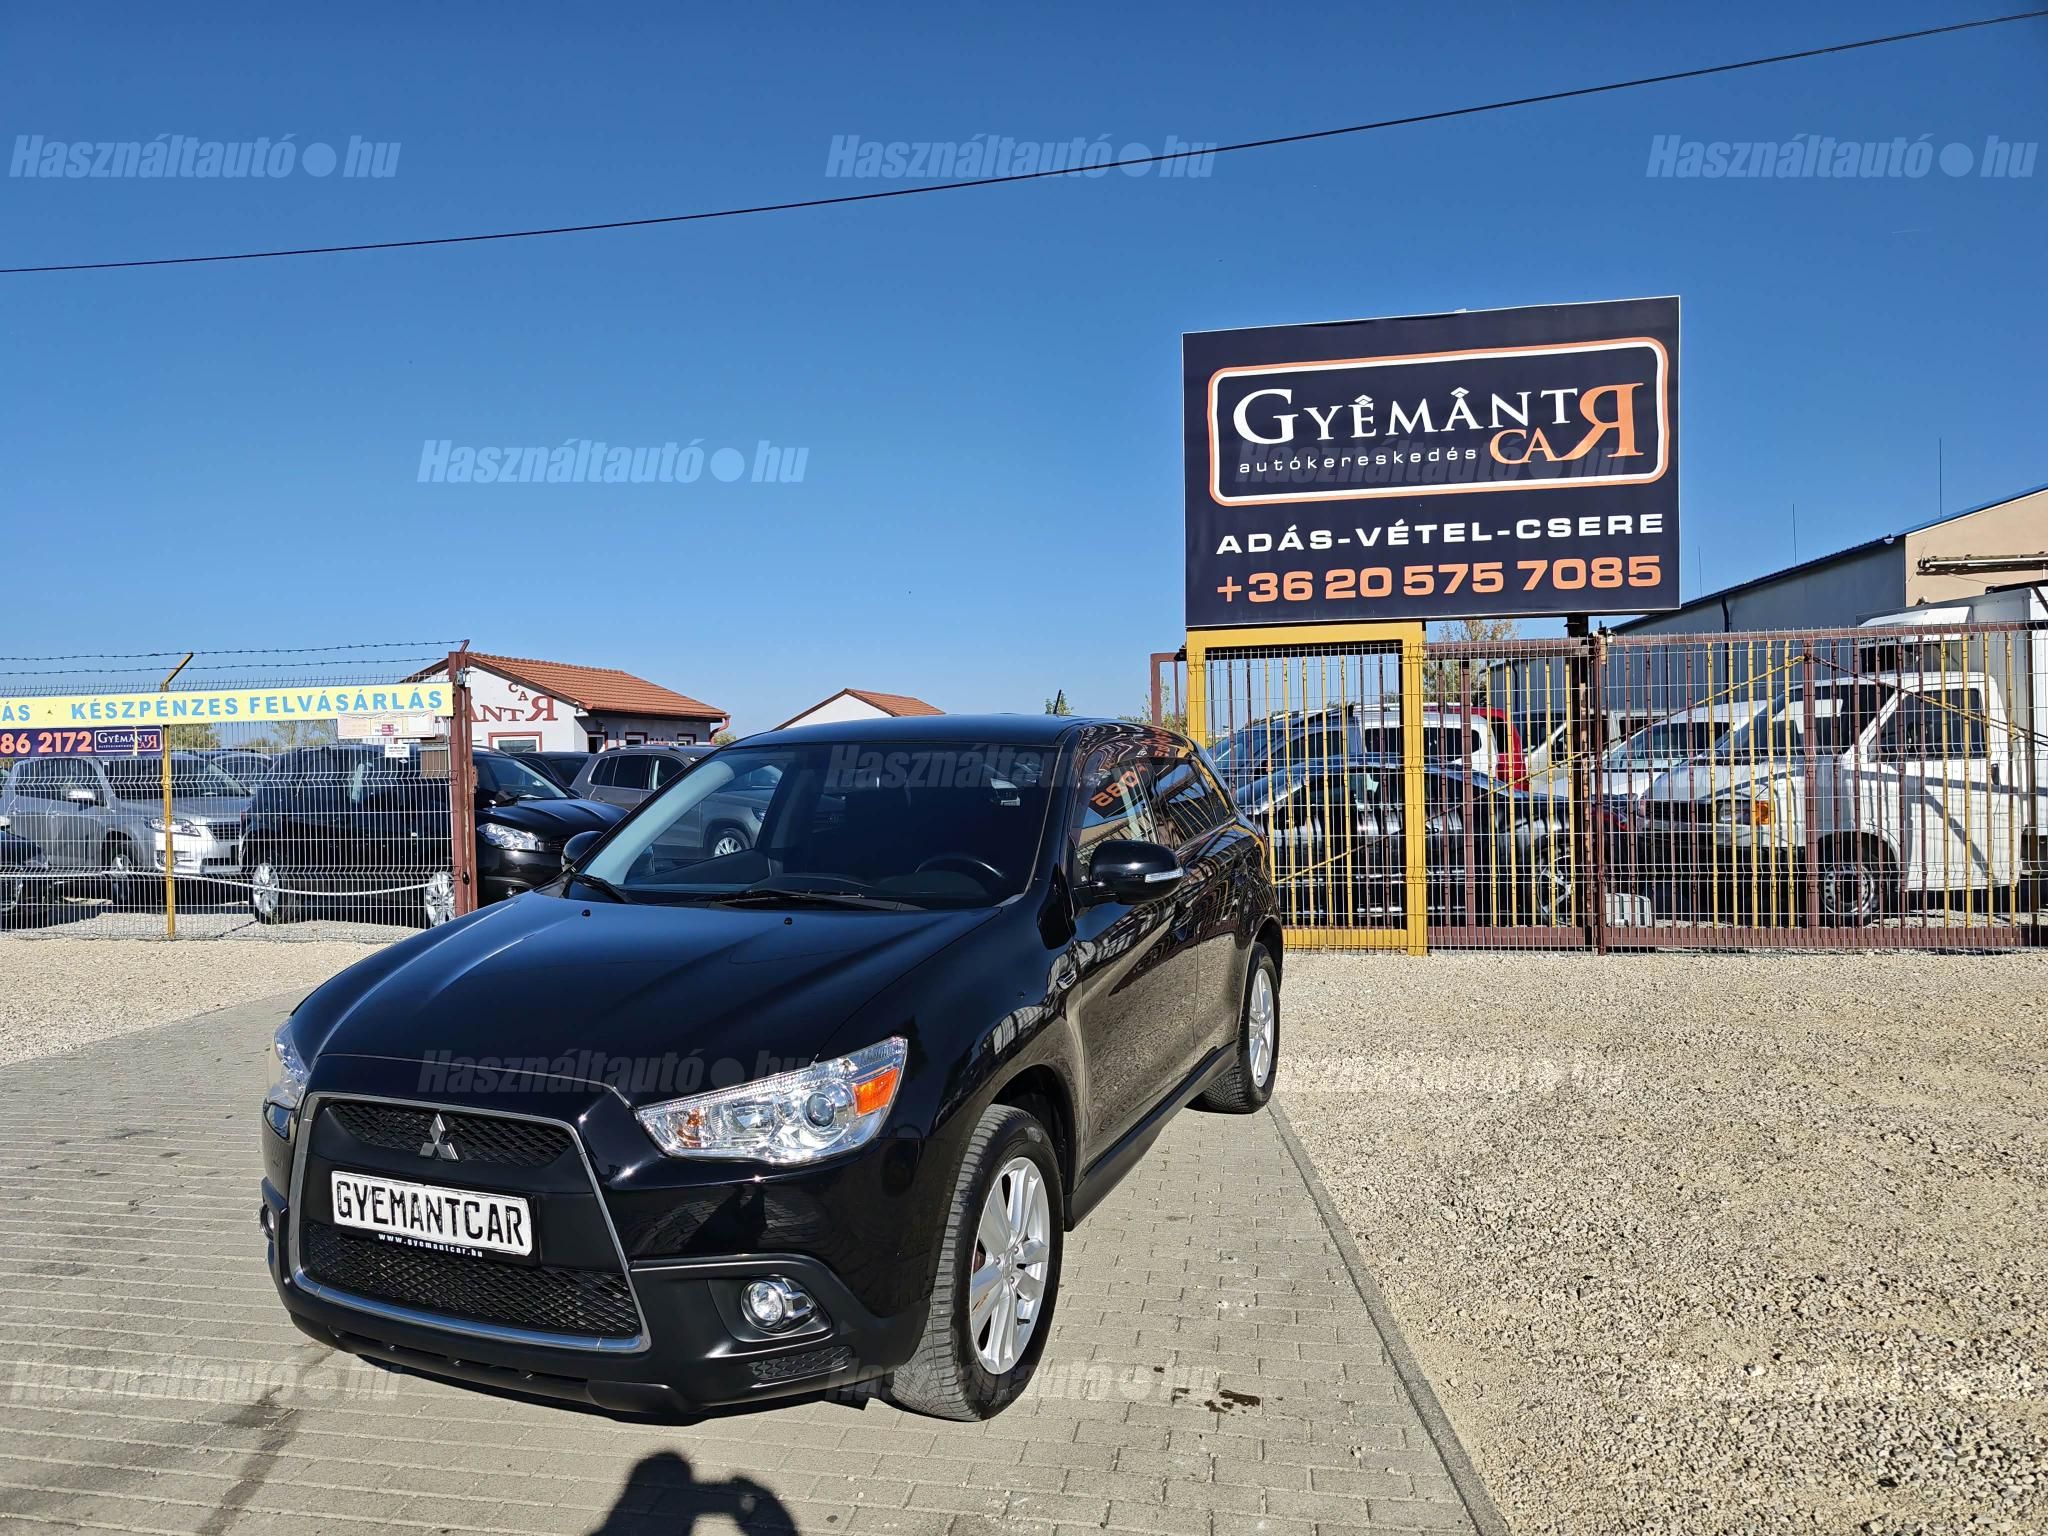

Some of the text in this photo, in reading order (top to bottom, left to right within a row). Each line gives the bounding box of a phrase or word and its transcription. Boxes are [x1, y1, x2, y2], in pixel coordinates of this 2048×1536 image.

[1239, 446, 1478, 474] autókereskedés
[1216, 513, 1664, 555] ADÁS-VÉTEL-CSERE
[1217, 554, 1662, 603] +36 20 575 7085
[71, 696, 239, 720] KÉSZPÉNZES
[250, 688, 443, 714] FELVÁSÁRLÁS
[37, 730, 93, 754] 2172
[335, 1179, 525, 1248] GYEMANTCAR
